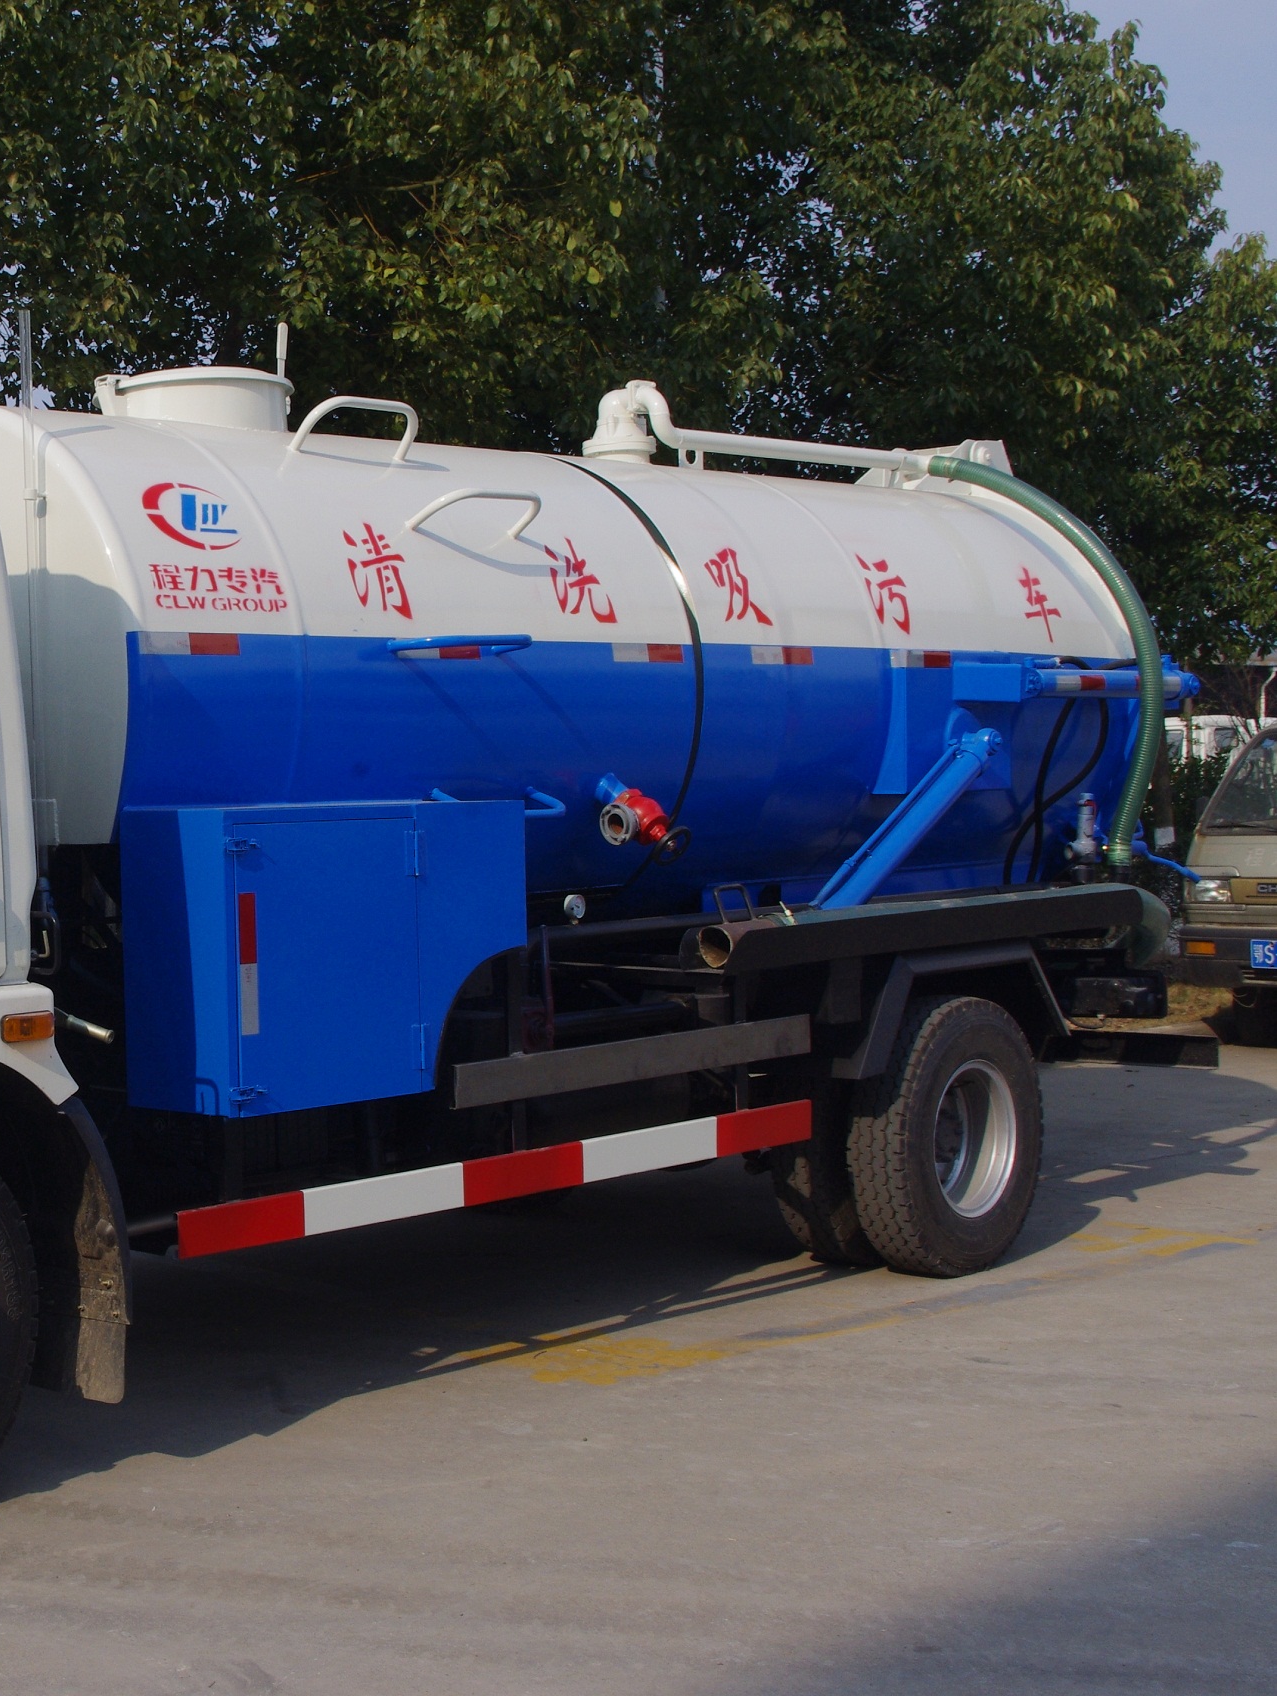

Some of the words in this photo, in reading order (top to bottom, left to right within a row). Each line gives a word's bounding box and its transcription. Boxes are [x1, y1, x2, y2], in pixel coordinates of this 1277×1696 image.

[149, 563, 284, 595] 程力专汽
[342, 521, 1062, 643] 清洗吸污车
[155, 594, 206, 610] CLW
[212, 597, 288, 613] GROUP
